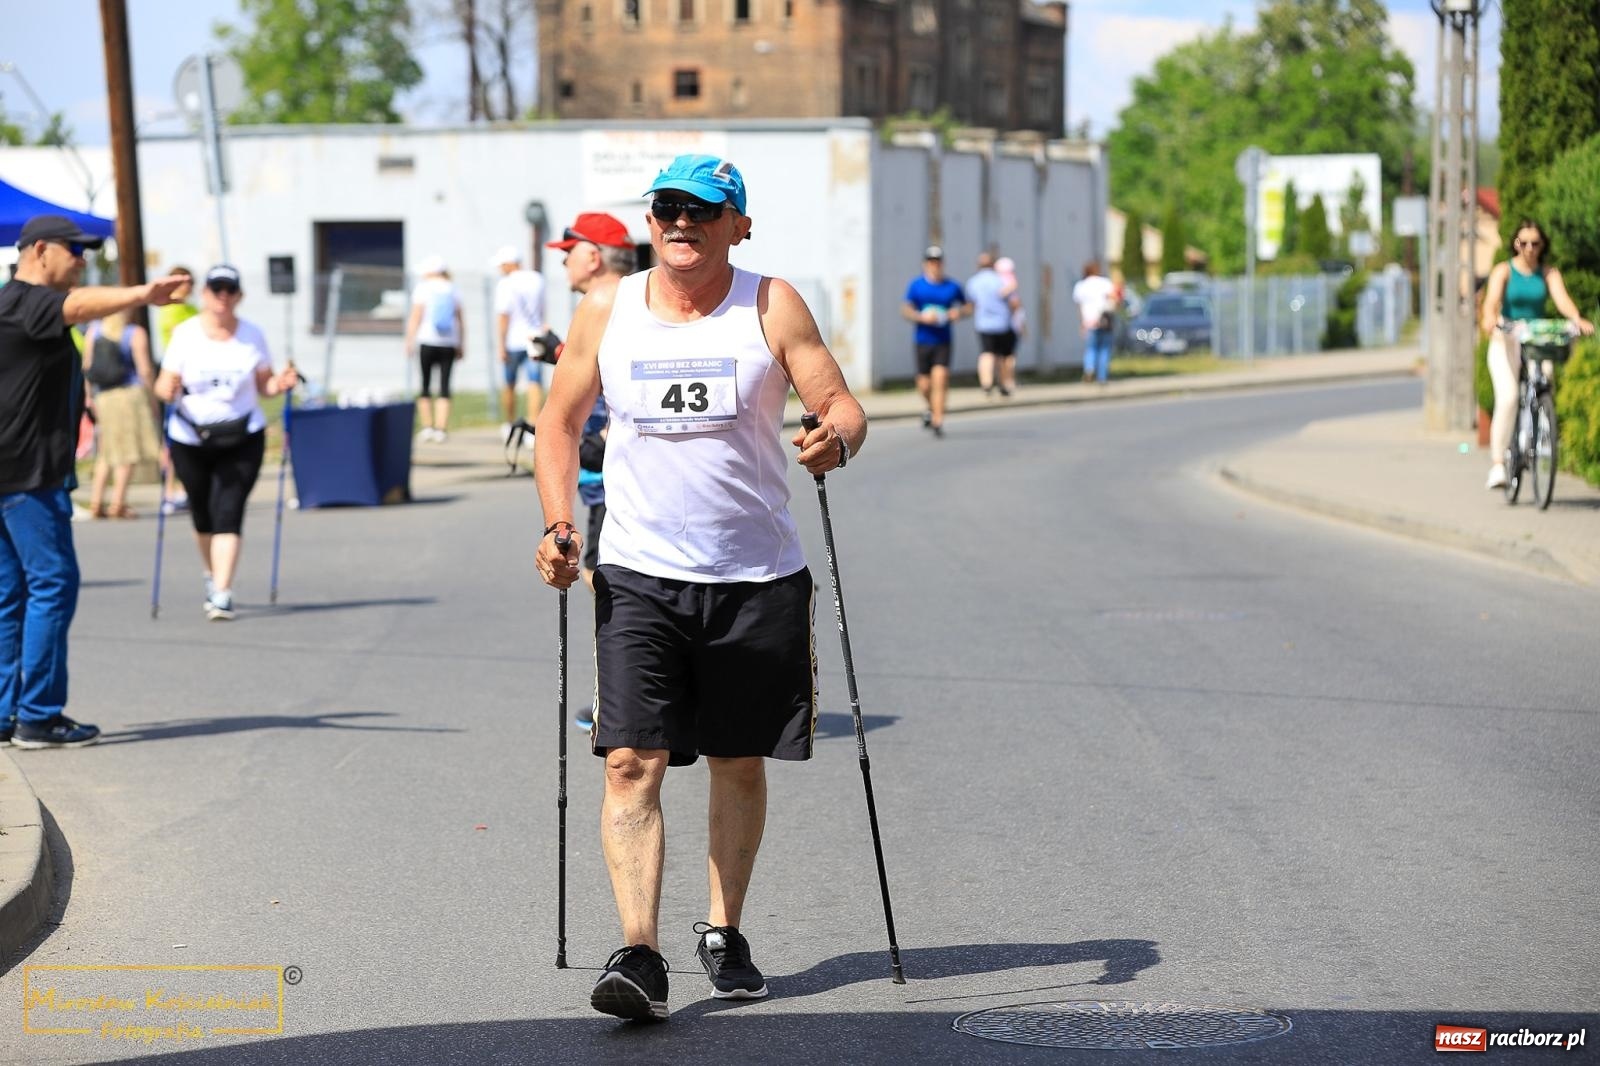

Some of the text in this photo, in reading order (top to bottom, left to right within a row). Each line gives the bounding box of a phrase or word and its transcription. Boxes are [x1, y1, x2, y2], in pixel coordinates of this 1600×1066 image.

[676, 361, 690, 369] BEZ
[691, 360, 723, 368] GRANIC
[661, 382, 709, 413] 43
